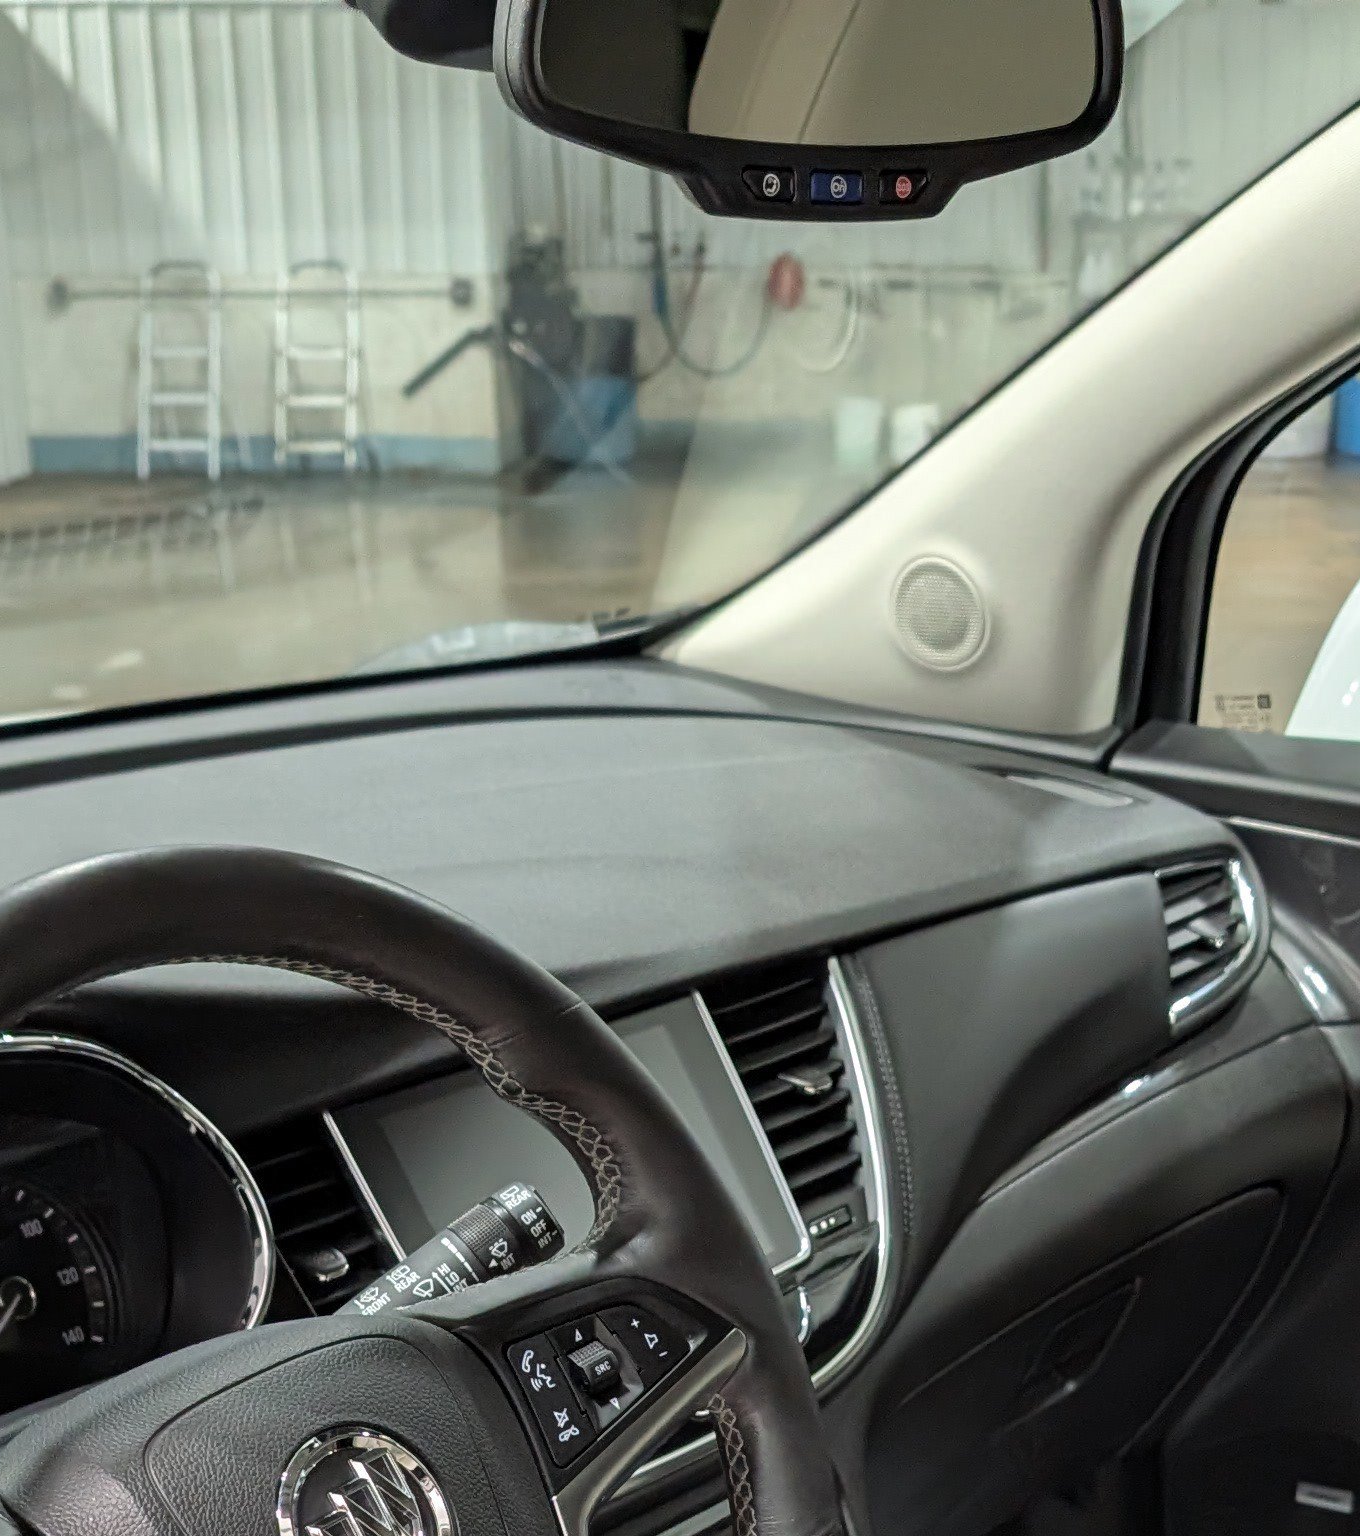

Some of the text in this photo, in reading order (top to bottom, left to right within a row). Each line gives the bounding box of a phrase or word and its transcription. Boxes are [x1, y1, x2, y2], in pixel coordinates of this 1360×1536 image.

[505, 1190, 532, 1210] REAR
[521, 1208, 538, 1225] ON
[20, 1218, 44, 1239] 100
[530, 1218, 547, 1237] OFF
[538, 1231, 552, 1248] INT
[437, 1262, 451, 1276] HI
[500, 1253, 515, 1270] INT
[56, 1266, 80, 1286] 120
[394, 1271, 421, 1293] REAR
[445, 1271, 460, 1286] LO
[361, 1292, 391, 1316] FRONT
[62, 1325, 86, 1346] 140
[594, 1360, 611, 1375] SRC
